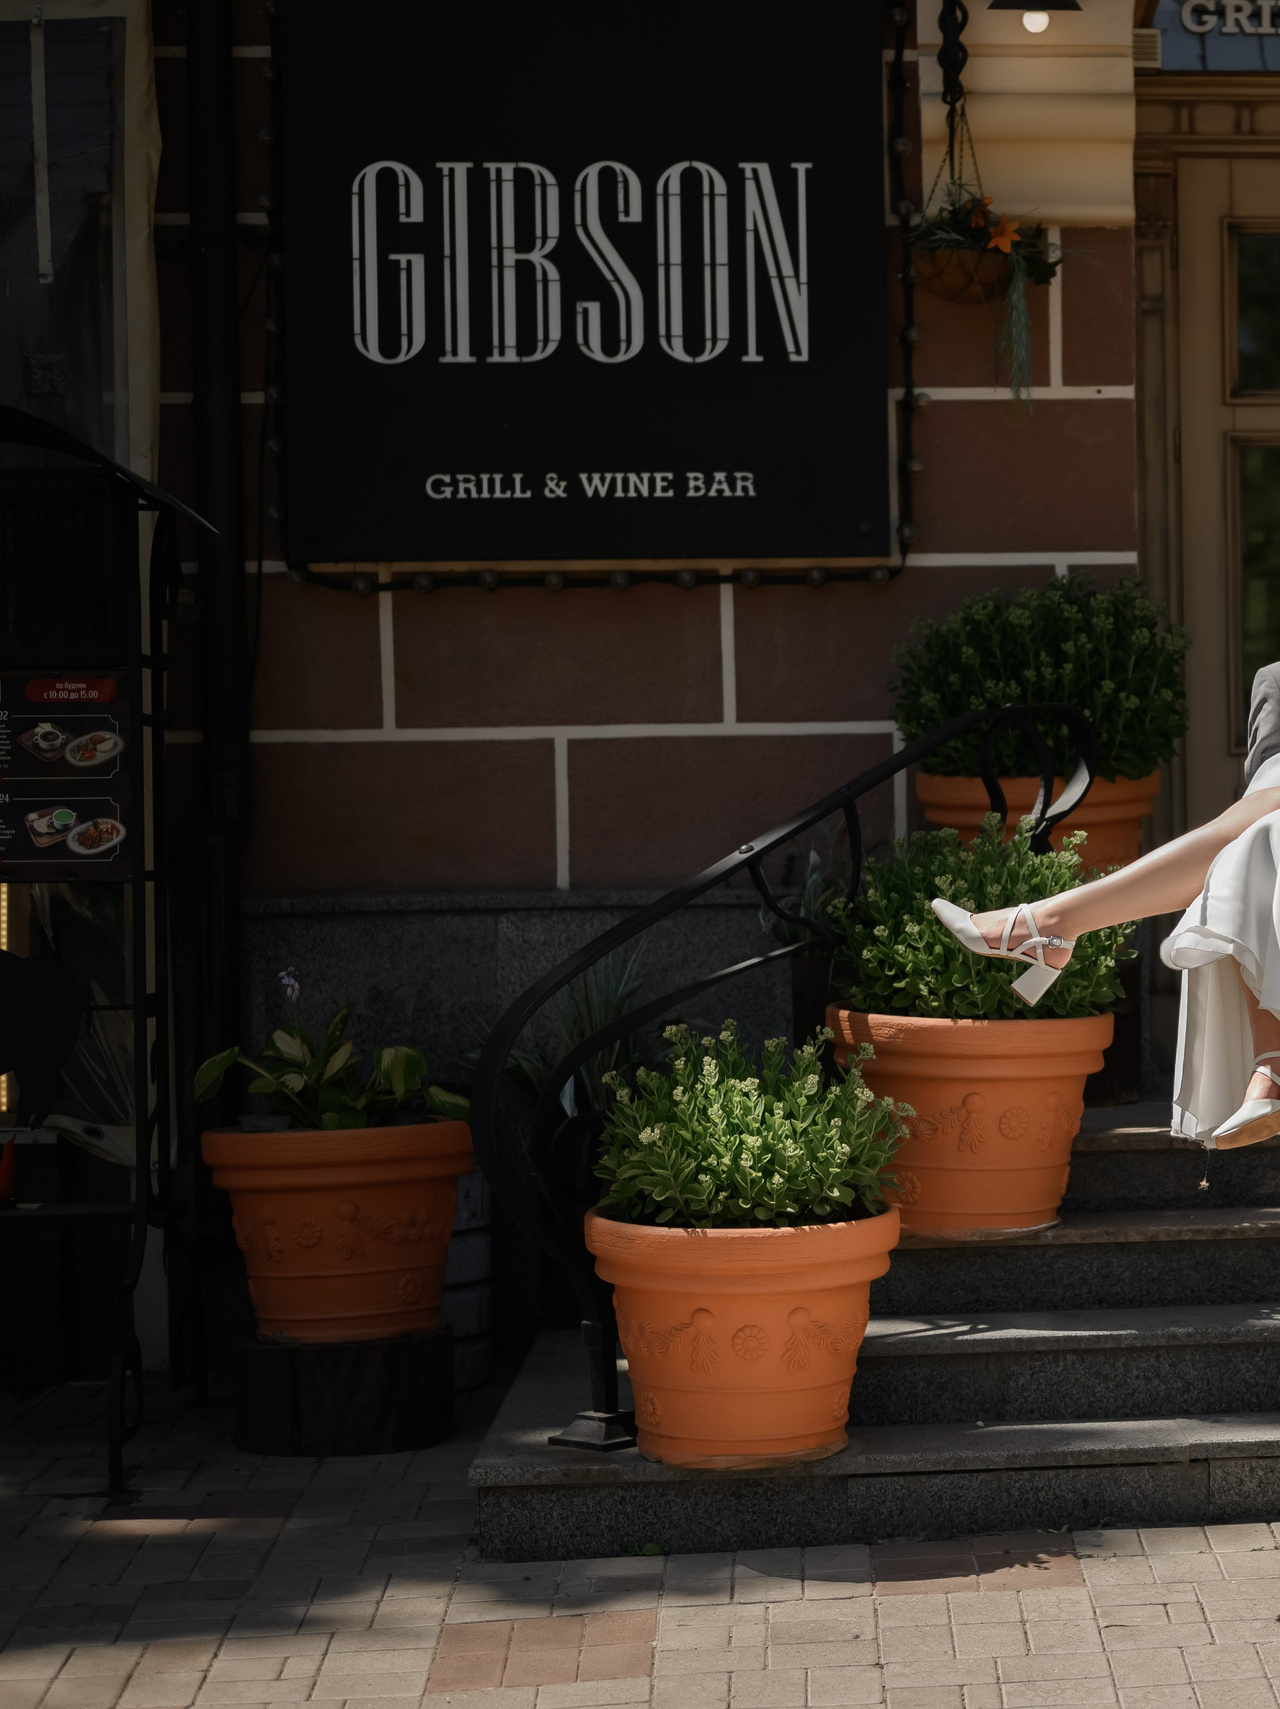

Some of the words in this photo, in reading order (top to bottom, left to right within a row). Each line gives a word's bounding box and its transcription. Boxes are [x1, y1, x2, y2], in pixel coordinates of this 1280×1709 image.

[352, 160, 813, 364] GIBSON
[425, 473, 532, 499] GRILL
[544, 472, 567, 498] &
[579, 472, 674, 498] WINE
[686, 471, 756, 497] BAR
[49, 690, 69, 699] 10:00
[69, 692, 79, 700] до
[80, 690, 99, 699] 15:00
